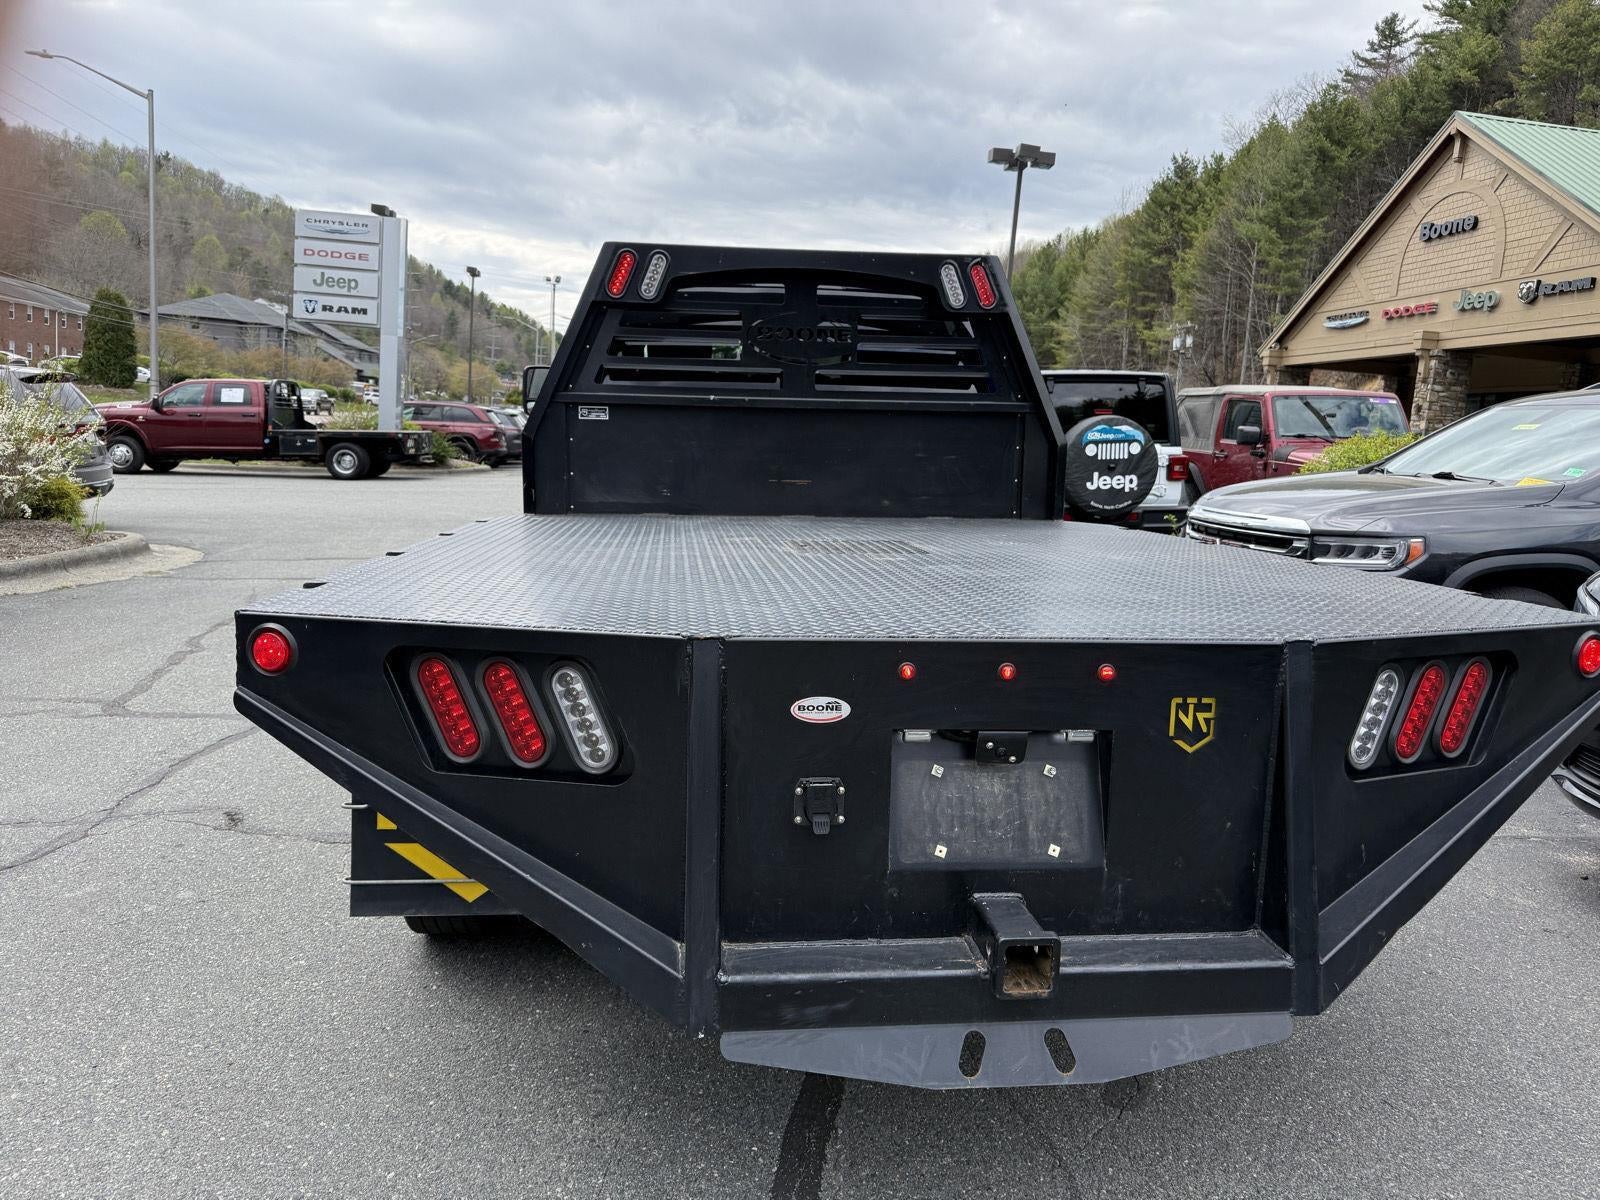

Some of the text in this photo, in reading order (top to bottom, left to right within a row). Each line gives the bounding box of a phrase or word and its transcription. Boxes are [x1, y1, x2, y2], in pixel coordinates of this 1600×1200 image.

[305, 217, 369, 228] CHRYSLER
[1419, 215, 1477, 241] Boone
[303, 248, 369, 261] DODGE
[313, 272, 359, 292] Jeep
[1539, 277, 1596, 295] RAM
[1453, 289, 1499, 311] Jeep
[321, 304, 368, 315] RAM
[1382, 302, 1438, 319] DODGE
[1086, 472, 1138, 492] Jeep
